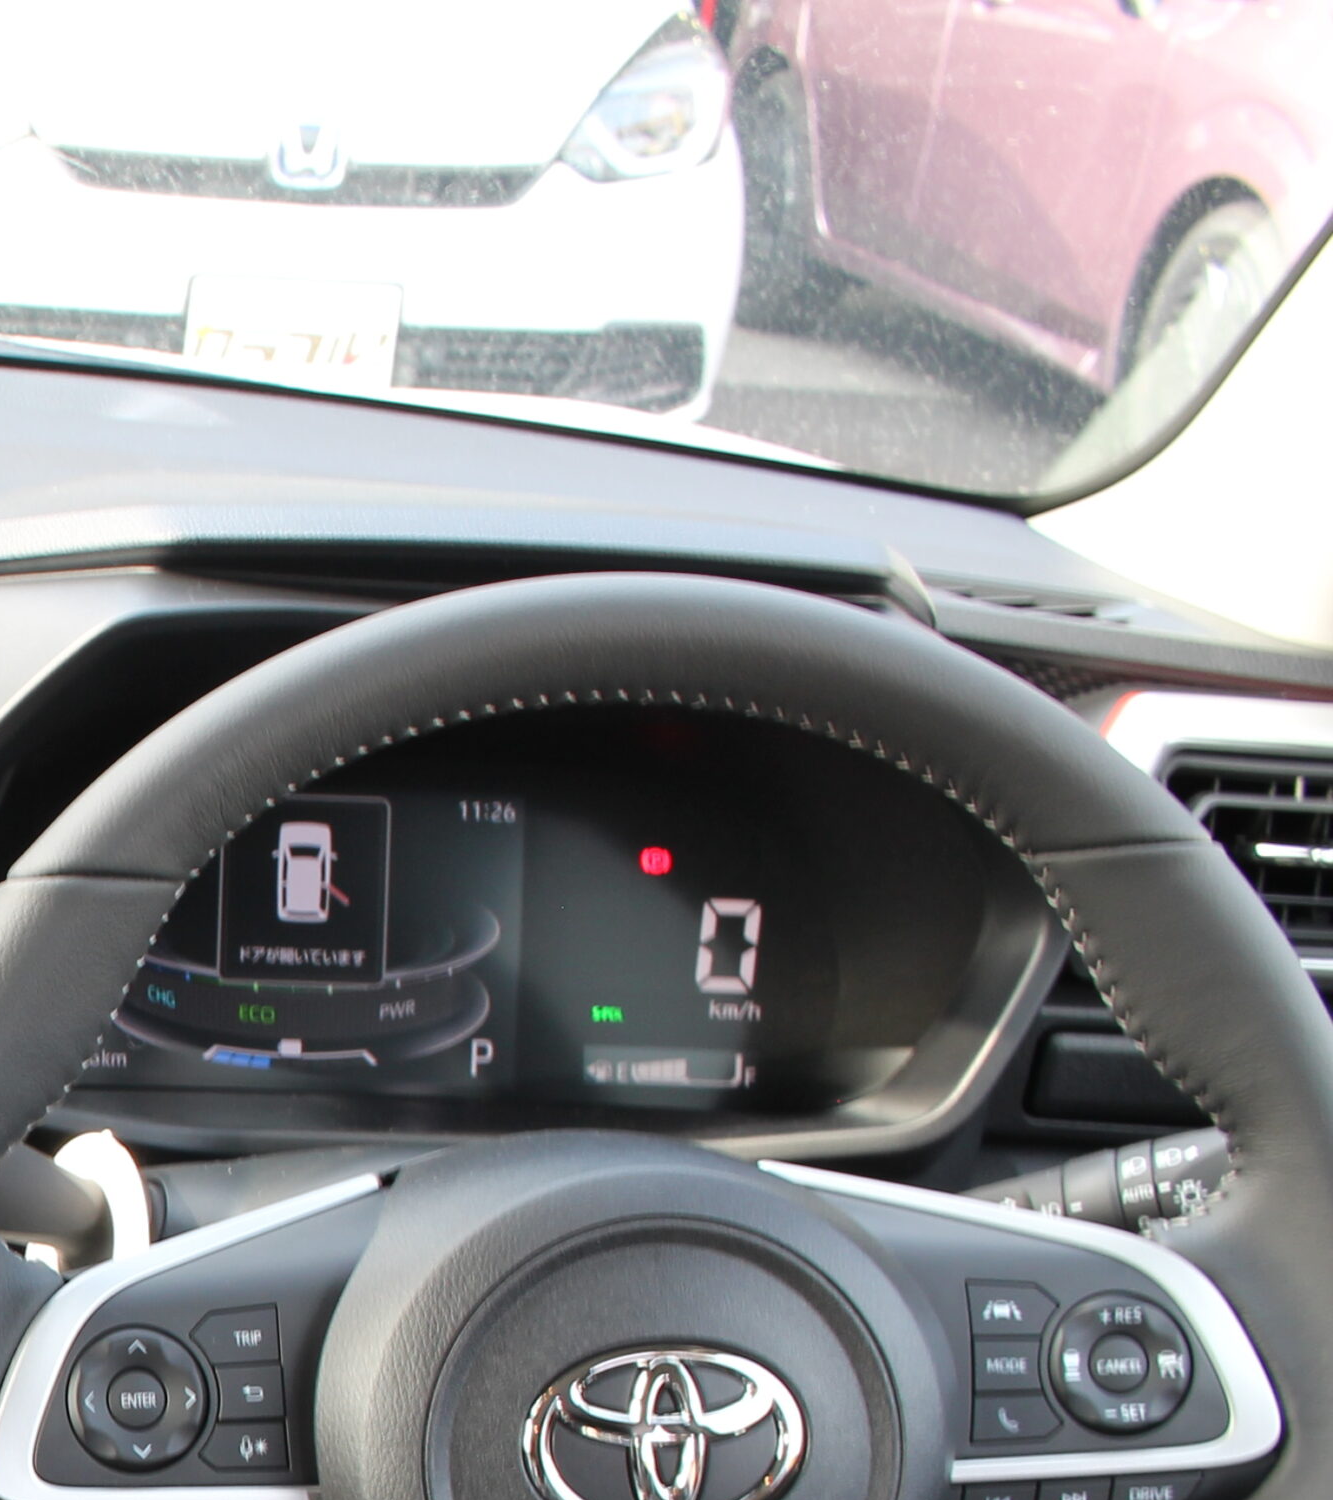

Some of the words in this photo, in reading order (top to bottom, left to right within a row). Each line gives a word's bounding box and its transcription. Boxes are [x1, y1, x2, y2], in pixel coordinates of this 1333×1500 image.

[459, 800, 517, 824] 11:26
[694, 897, 762, 995] 0
[146, 983, 177, 1009] CHG
[238, 1003, 276, 1025] ECO
[378, 998, 417, 1022] PWR
[707, 999, 762, 1022] km/h
[469, 1037, 494, 1079] P
[1121, 1182, 1156, 1204] AUTO
[1114, 1306, 1143, 1326] RES
[233, 1329, 263, 1347] TRIP
[985, 1357, 1028, 1375] MODE
[1096, 1357, 1143, 1376] CANCEL
[120, 1390, 157, 1409] ENTER
[1119, 1402, 1147, 1423] SET
